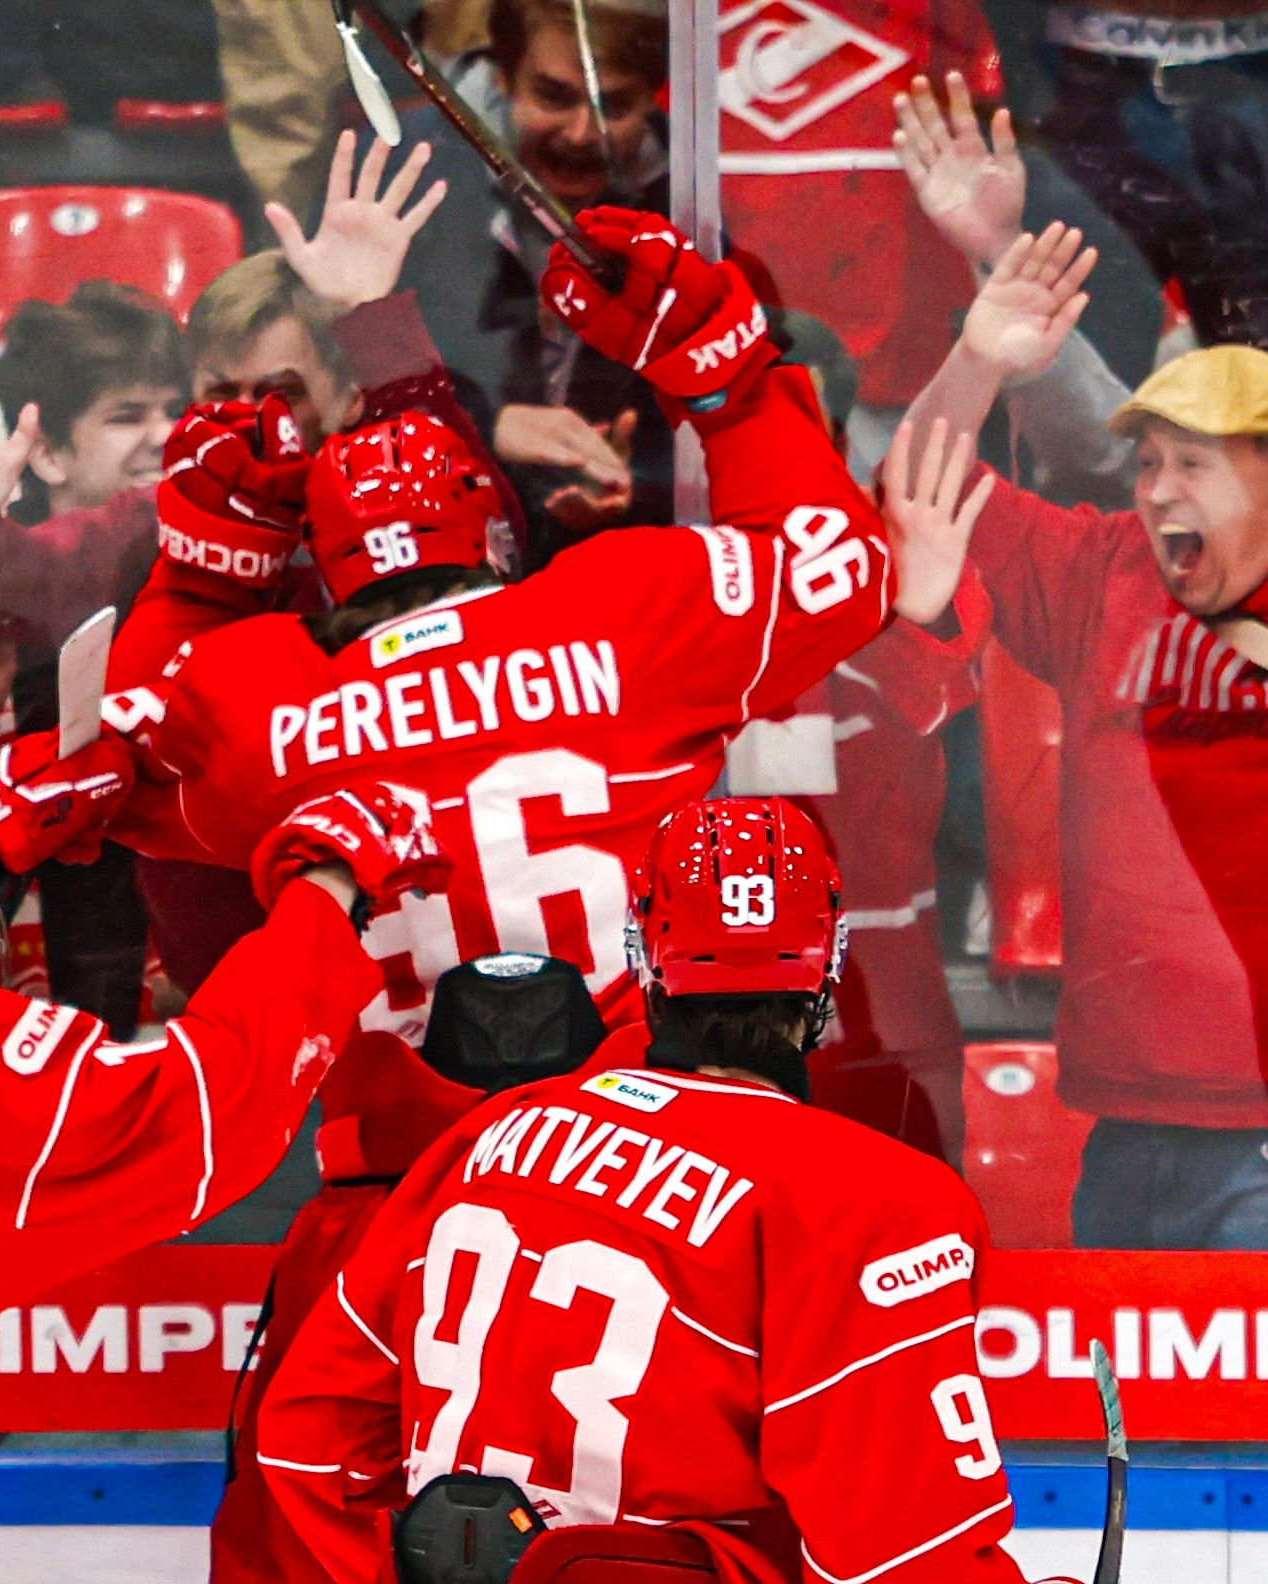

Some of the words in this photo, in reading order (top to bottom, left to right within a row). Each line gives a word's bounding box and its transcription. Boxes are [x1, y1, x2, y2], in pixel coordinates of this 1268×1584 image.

[364, 520, 419, 575] 96
[783, 504, 869, 615] 96
[270, 639, 620, 778] PERELYGIN
[720, 873, 775, 926] 93
[616, 1084, 661, 1104] БАНК
[463, 1105, 754, 1248] MATVEYEV
[406, 1202, 671, 1531] 93
[974, 1306, 1268, 1382] OLIM
